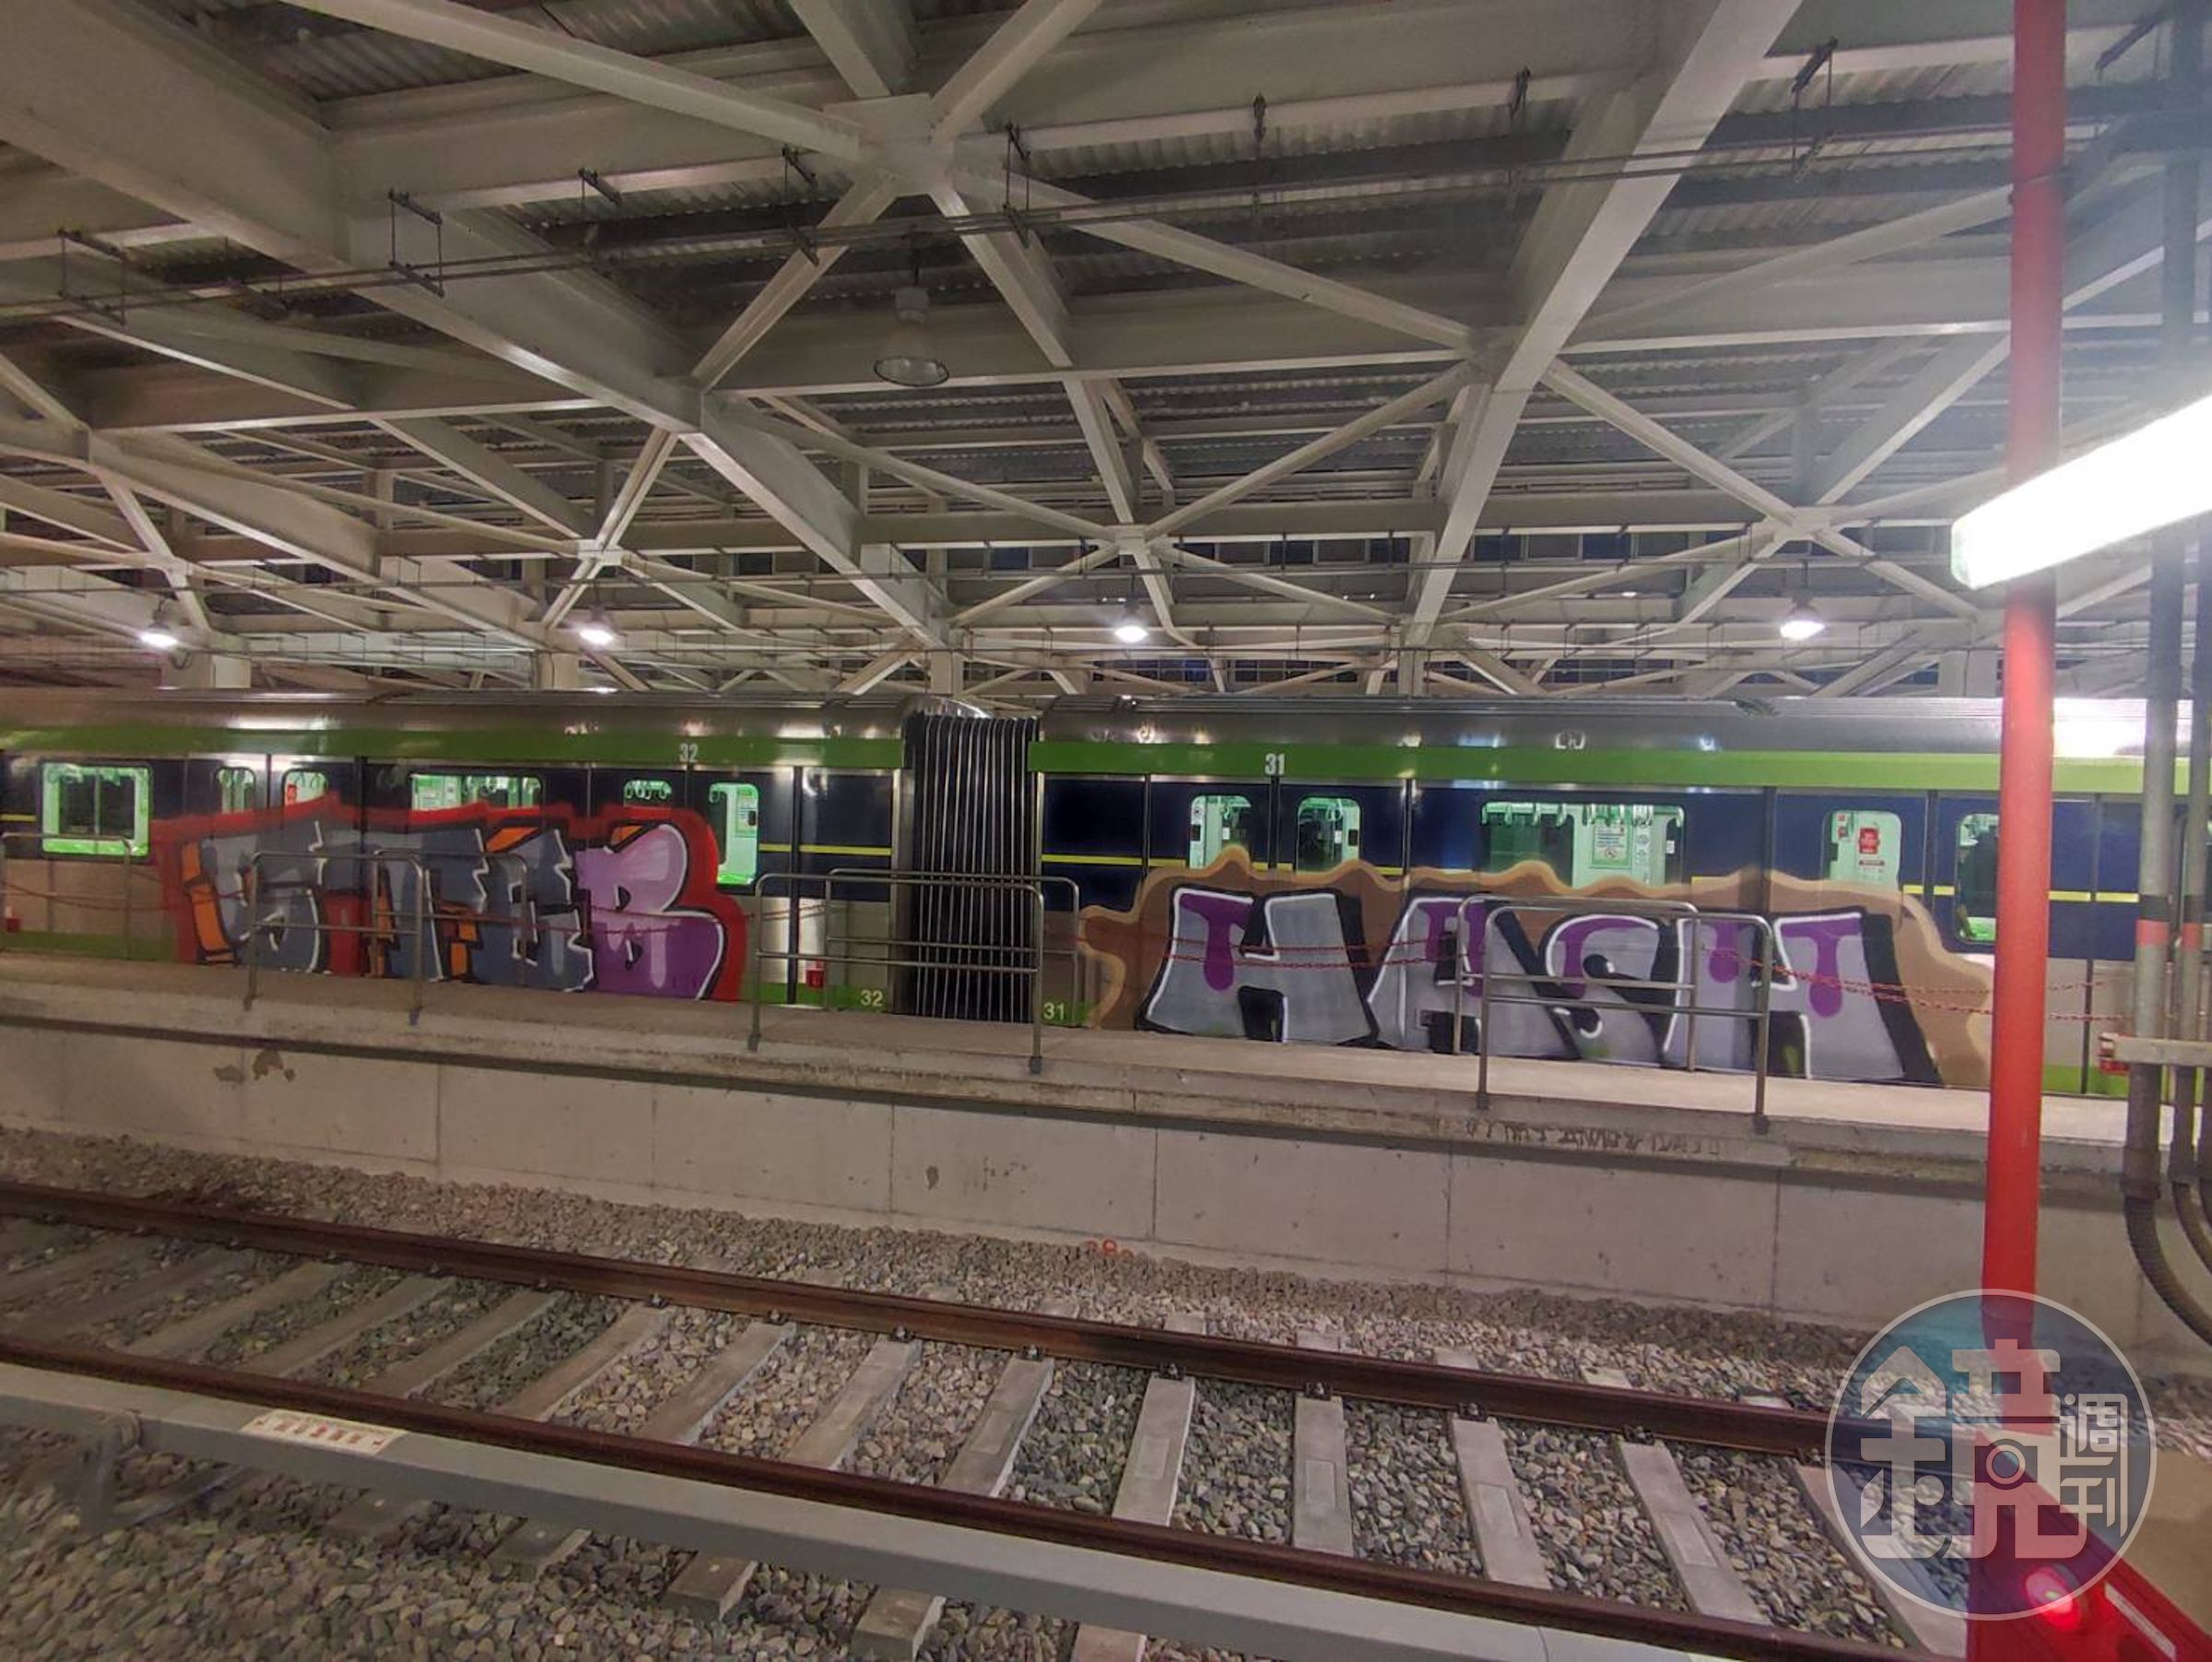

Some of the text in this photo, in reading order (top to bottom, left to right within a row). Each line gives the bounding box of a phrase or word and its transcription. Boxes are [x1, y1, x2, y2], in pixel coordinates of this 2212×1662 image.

[679, 742, 699, 763] 32
[1265, 752, 1285, 775] 31
[860, 989, 884, 1008] 32
[1042, 1001, 1065, 1020] 31
